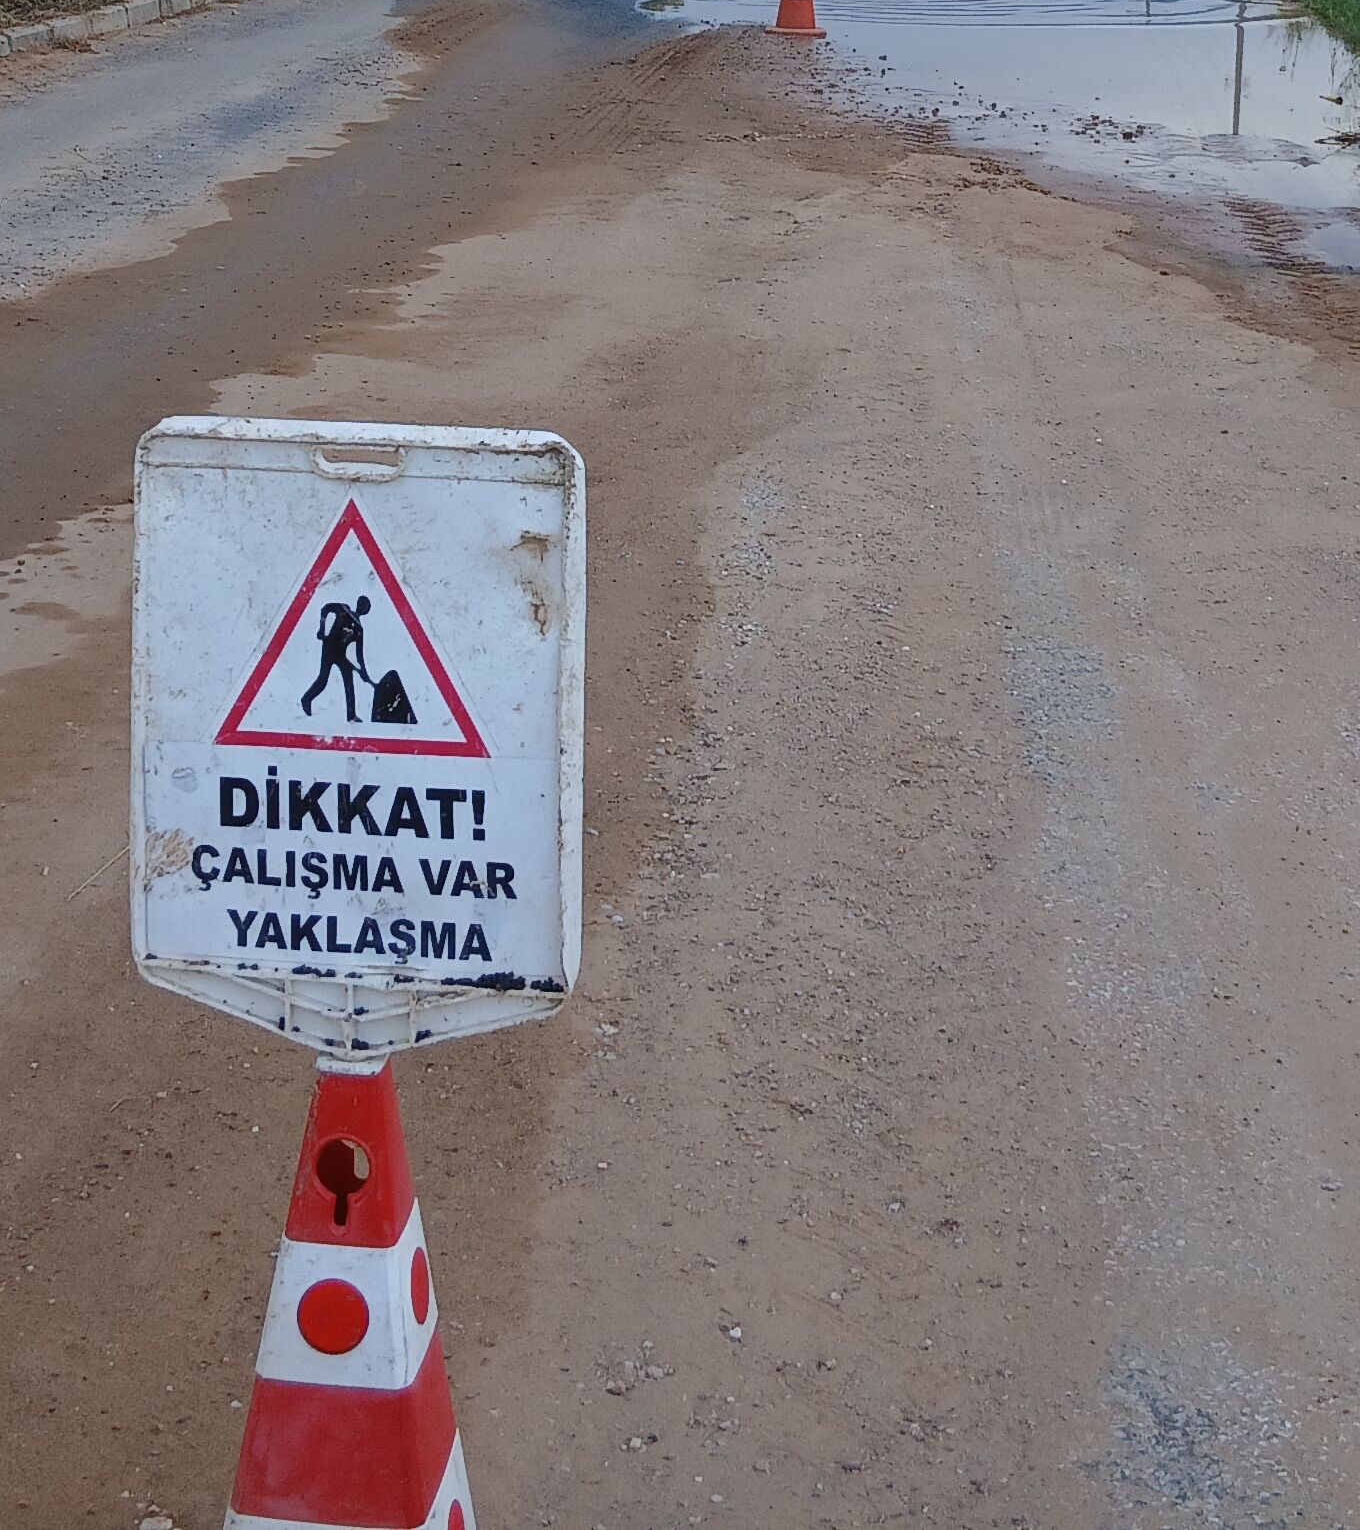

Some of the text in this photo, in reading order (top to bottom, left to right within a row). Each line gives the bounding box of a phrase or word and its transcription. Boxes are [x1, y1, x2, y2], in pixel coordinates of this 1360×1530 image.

[217, 766, 488, 841] DİKKAT!
[191, 844, 516, 900] ÇALIŞMA VAR
[228, 908, 493, 965] YAKLAŞMA
